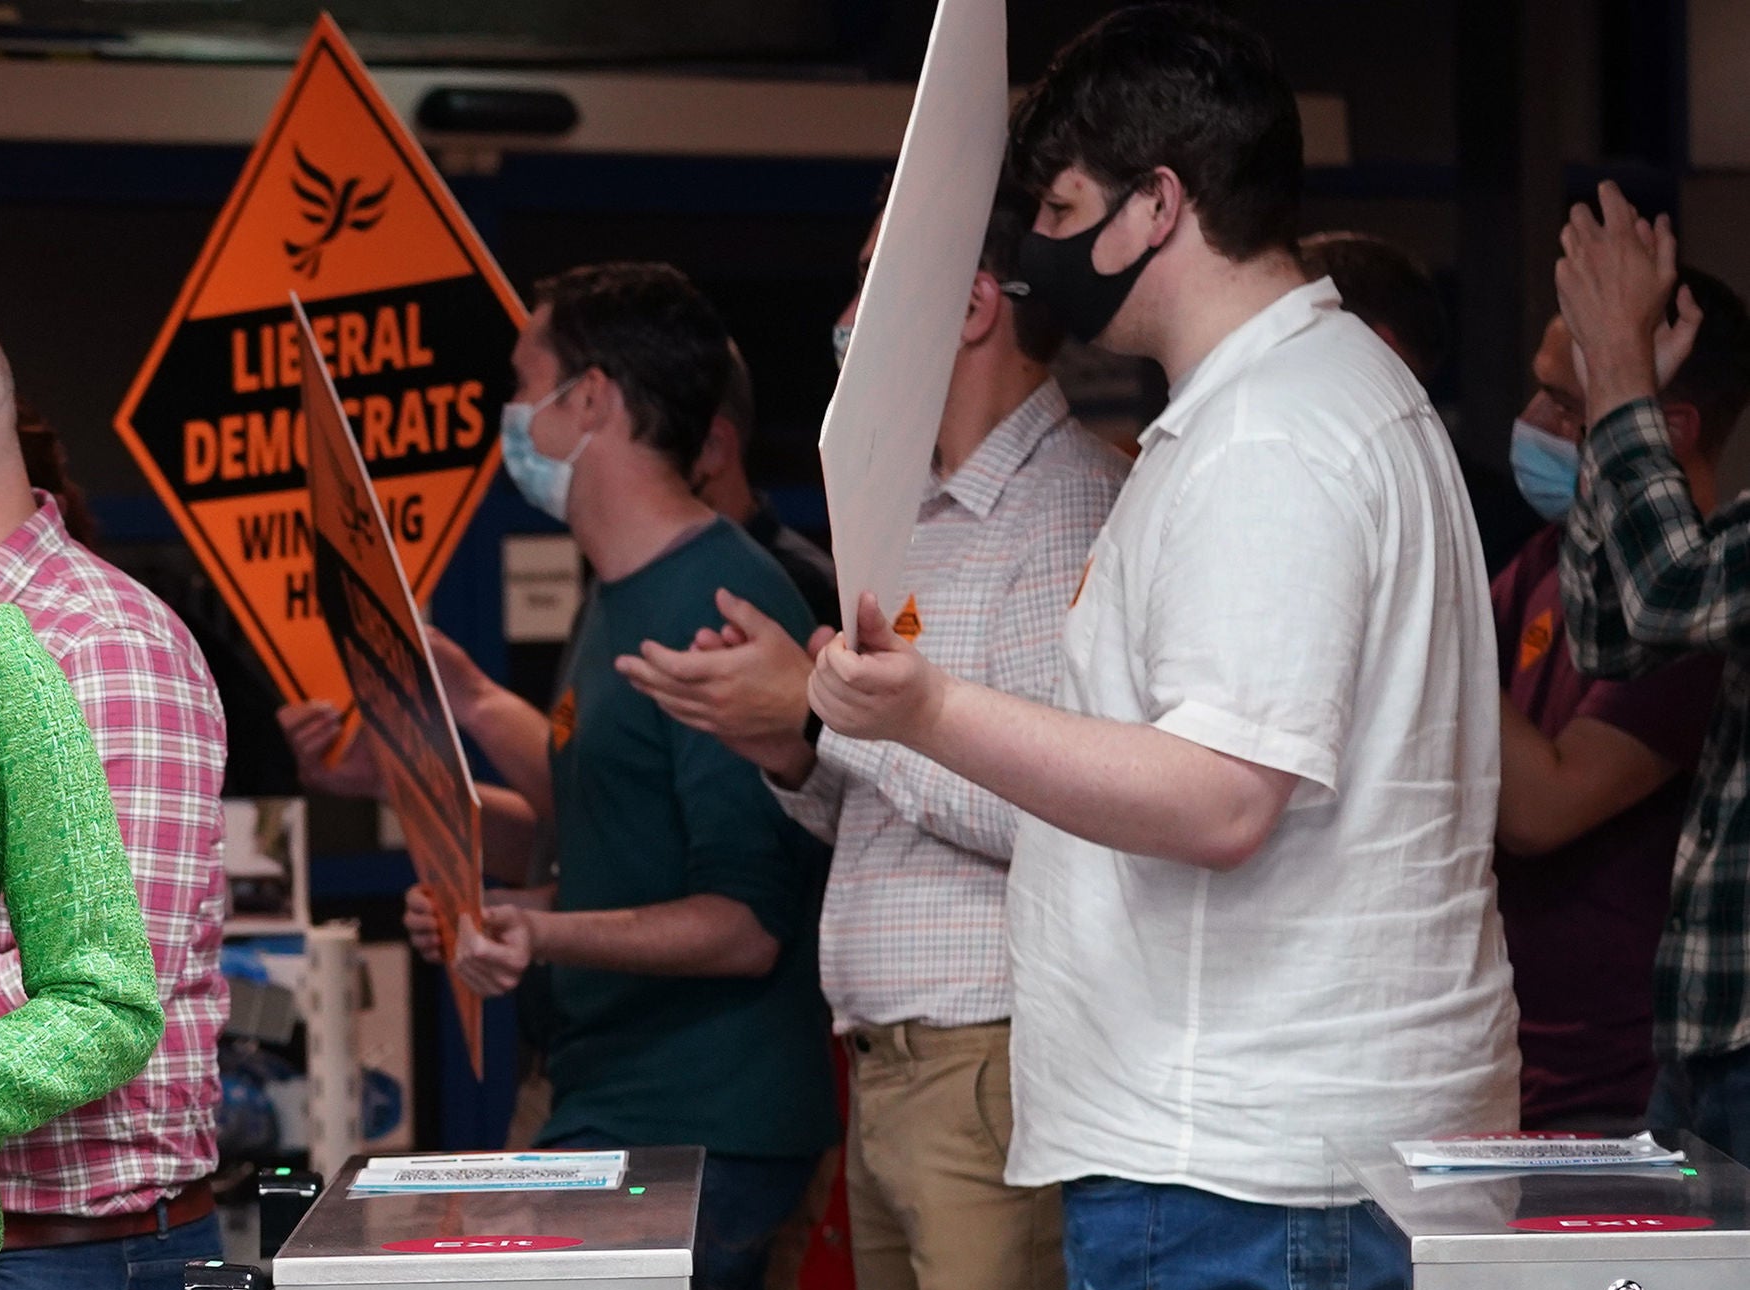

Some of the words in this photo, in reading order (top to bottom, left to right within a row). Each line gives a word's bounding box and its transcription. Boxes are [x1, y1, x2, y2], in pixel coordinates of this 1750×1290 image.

[232, 302, 434, 394] LIBERAL
[184, 380, 485, 485] DEMRATS
[433, 1240, 533, 1248] Exit
[1559, 1219, 1664, 1227] Exit
